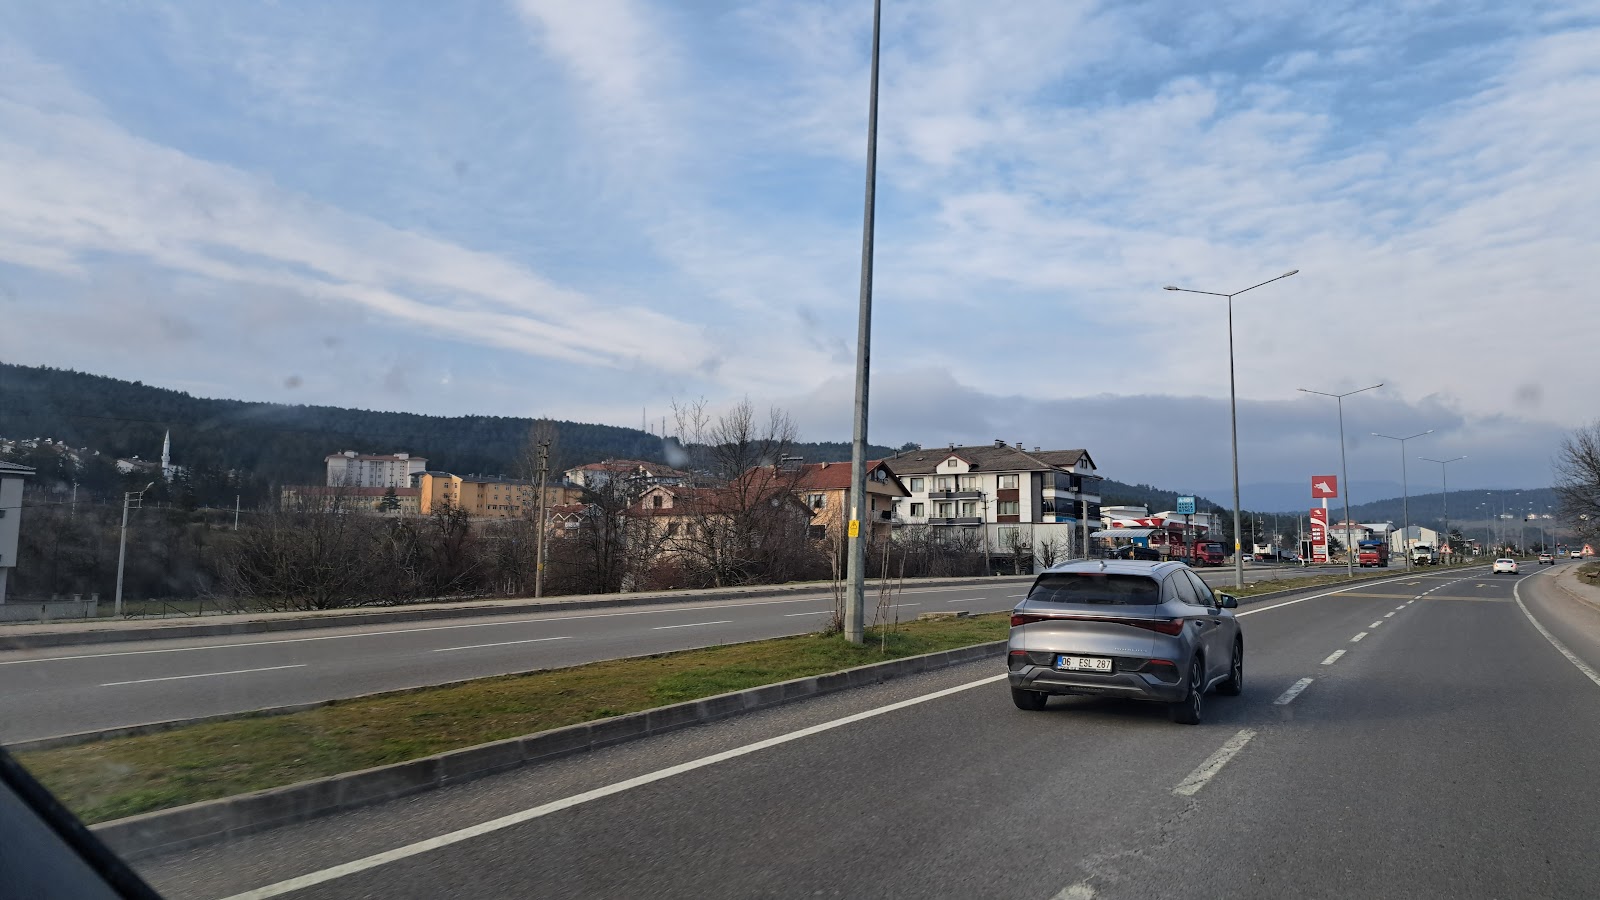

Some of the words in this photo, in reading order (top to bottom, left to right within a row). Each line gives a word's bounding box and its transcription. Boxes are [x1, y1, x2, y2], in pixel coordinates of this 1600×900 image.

[1062, 657, 1071, 666] 06
[1079, 658, 1092, 667] ESL
[1096, 659, 1110, 668] 287
